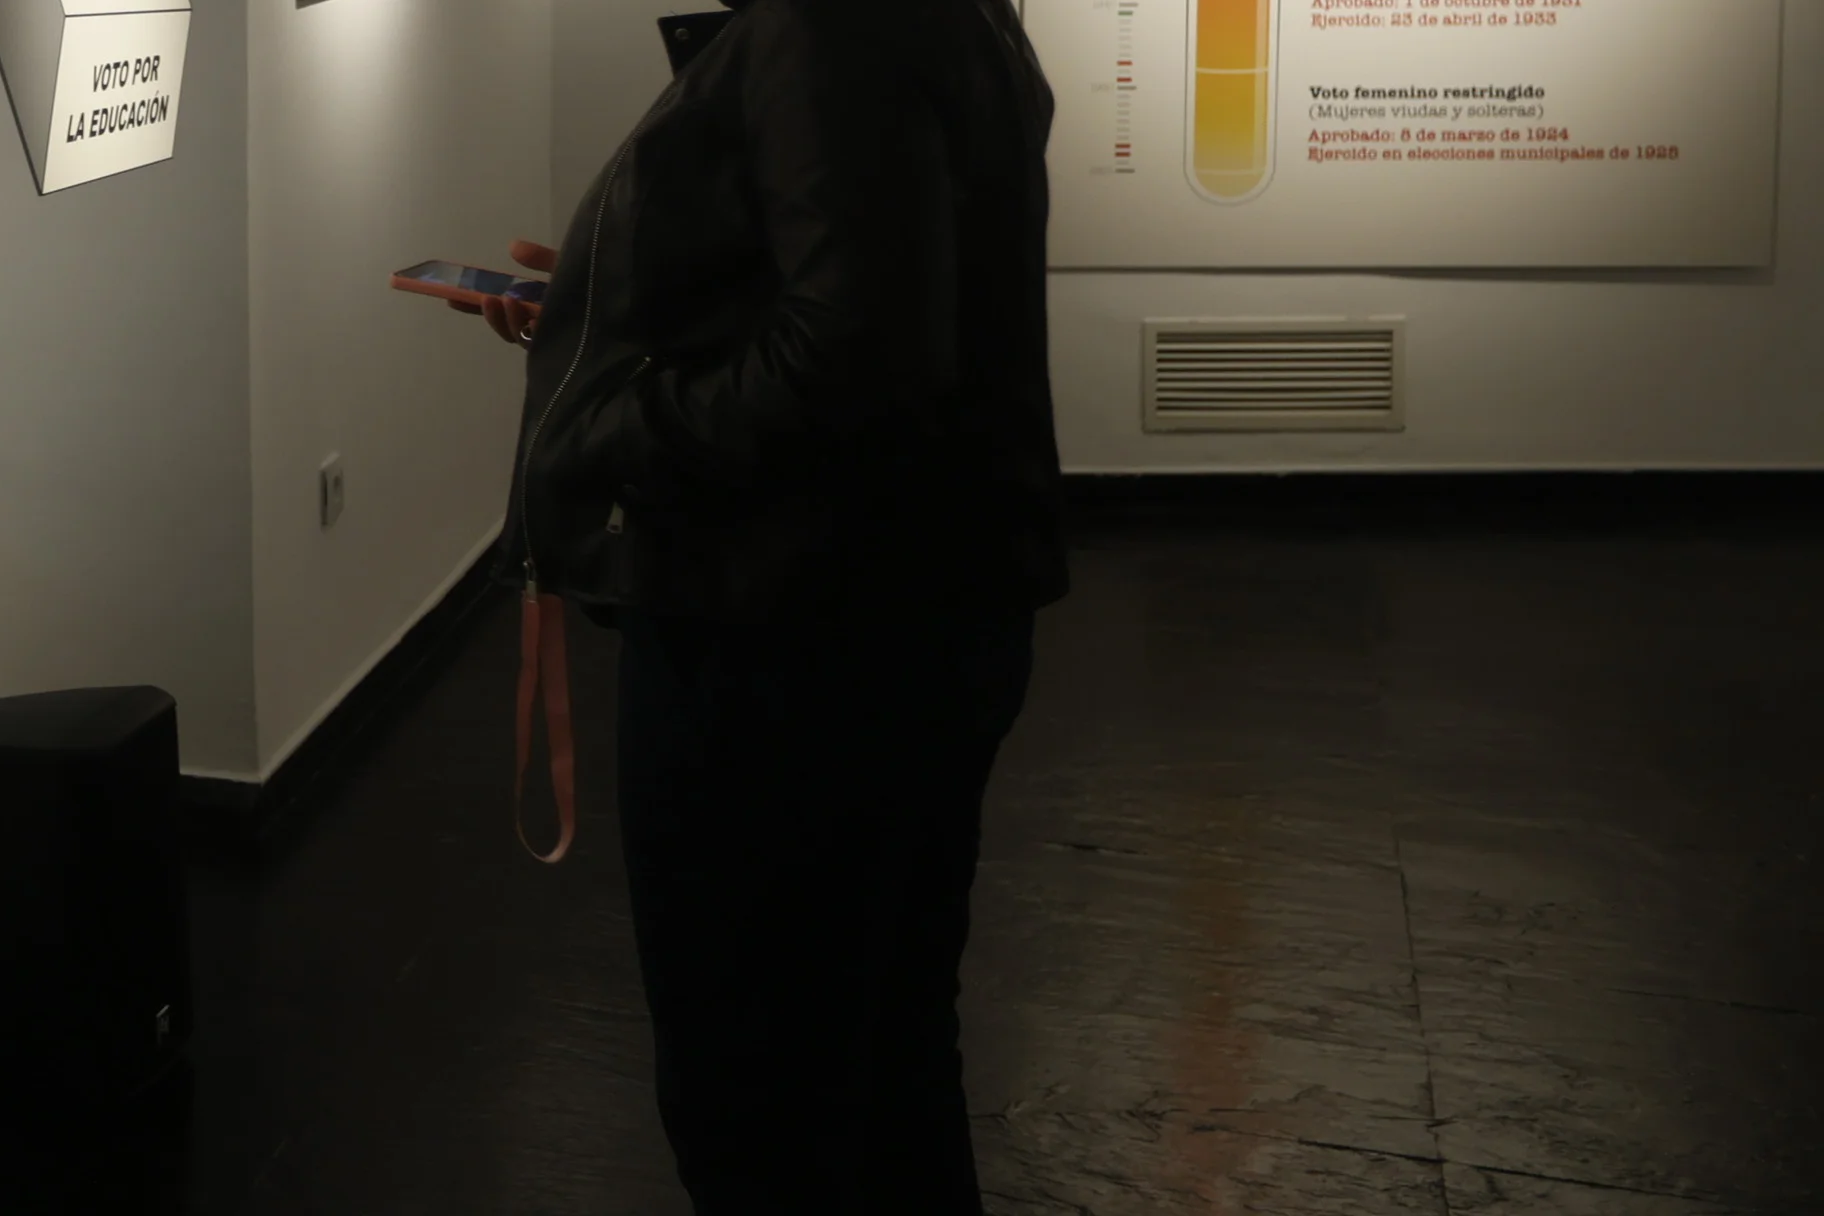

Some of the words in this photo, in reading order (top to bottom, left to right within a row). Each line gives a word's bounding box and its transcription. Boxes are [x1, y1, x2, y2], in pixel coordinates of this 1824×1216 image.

[1418, 12, 1438, 26] de
[1443, 11, 1482, 27] abril
[1487, 12, 1508, 26] de
[93, 60, 129, 92] VOTO
[132, 55, 160, 85] POR
[1309, 85, 1349, 99] Voto
[1354, 84, 1438, 99] femenino
[1443, 83, 1545, 100] restringido
[66, 112, 84, 143] LA
[89, 90, 169, 138] EDUCACIÓN
[1308, 104, 1386, 121] (Mujeres
[1390, 103, 1447, 118] viudas
[1451, 106, 1462, 121] y
[1467, 103, 1545, 120] solteras)
[1308, 128, 1394, 145] Aprobado:
[1416, 128, 1436, 142] de
[1441, 130, 1496, 142] marzo
[1500, 127, 1520, 141] de
[1307, 146, 1378, 164] Ejercido
[1382, 148, 1403, 161] en
[1407, 146, 1495, 161] elecciones
[1500, 145, 1605, 163] municipales
[1608, 145, 1630, 160] de
